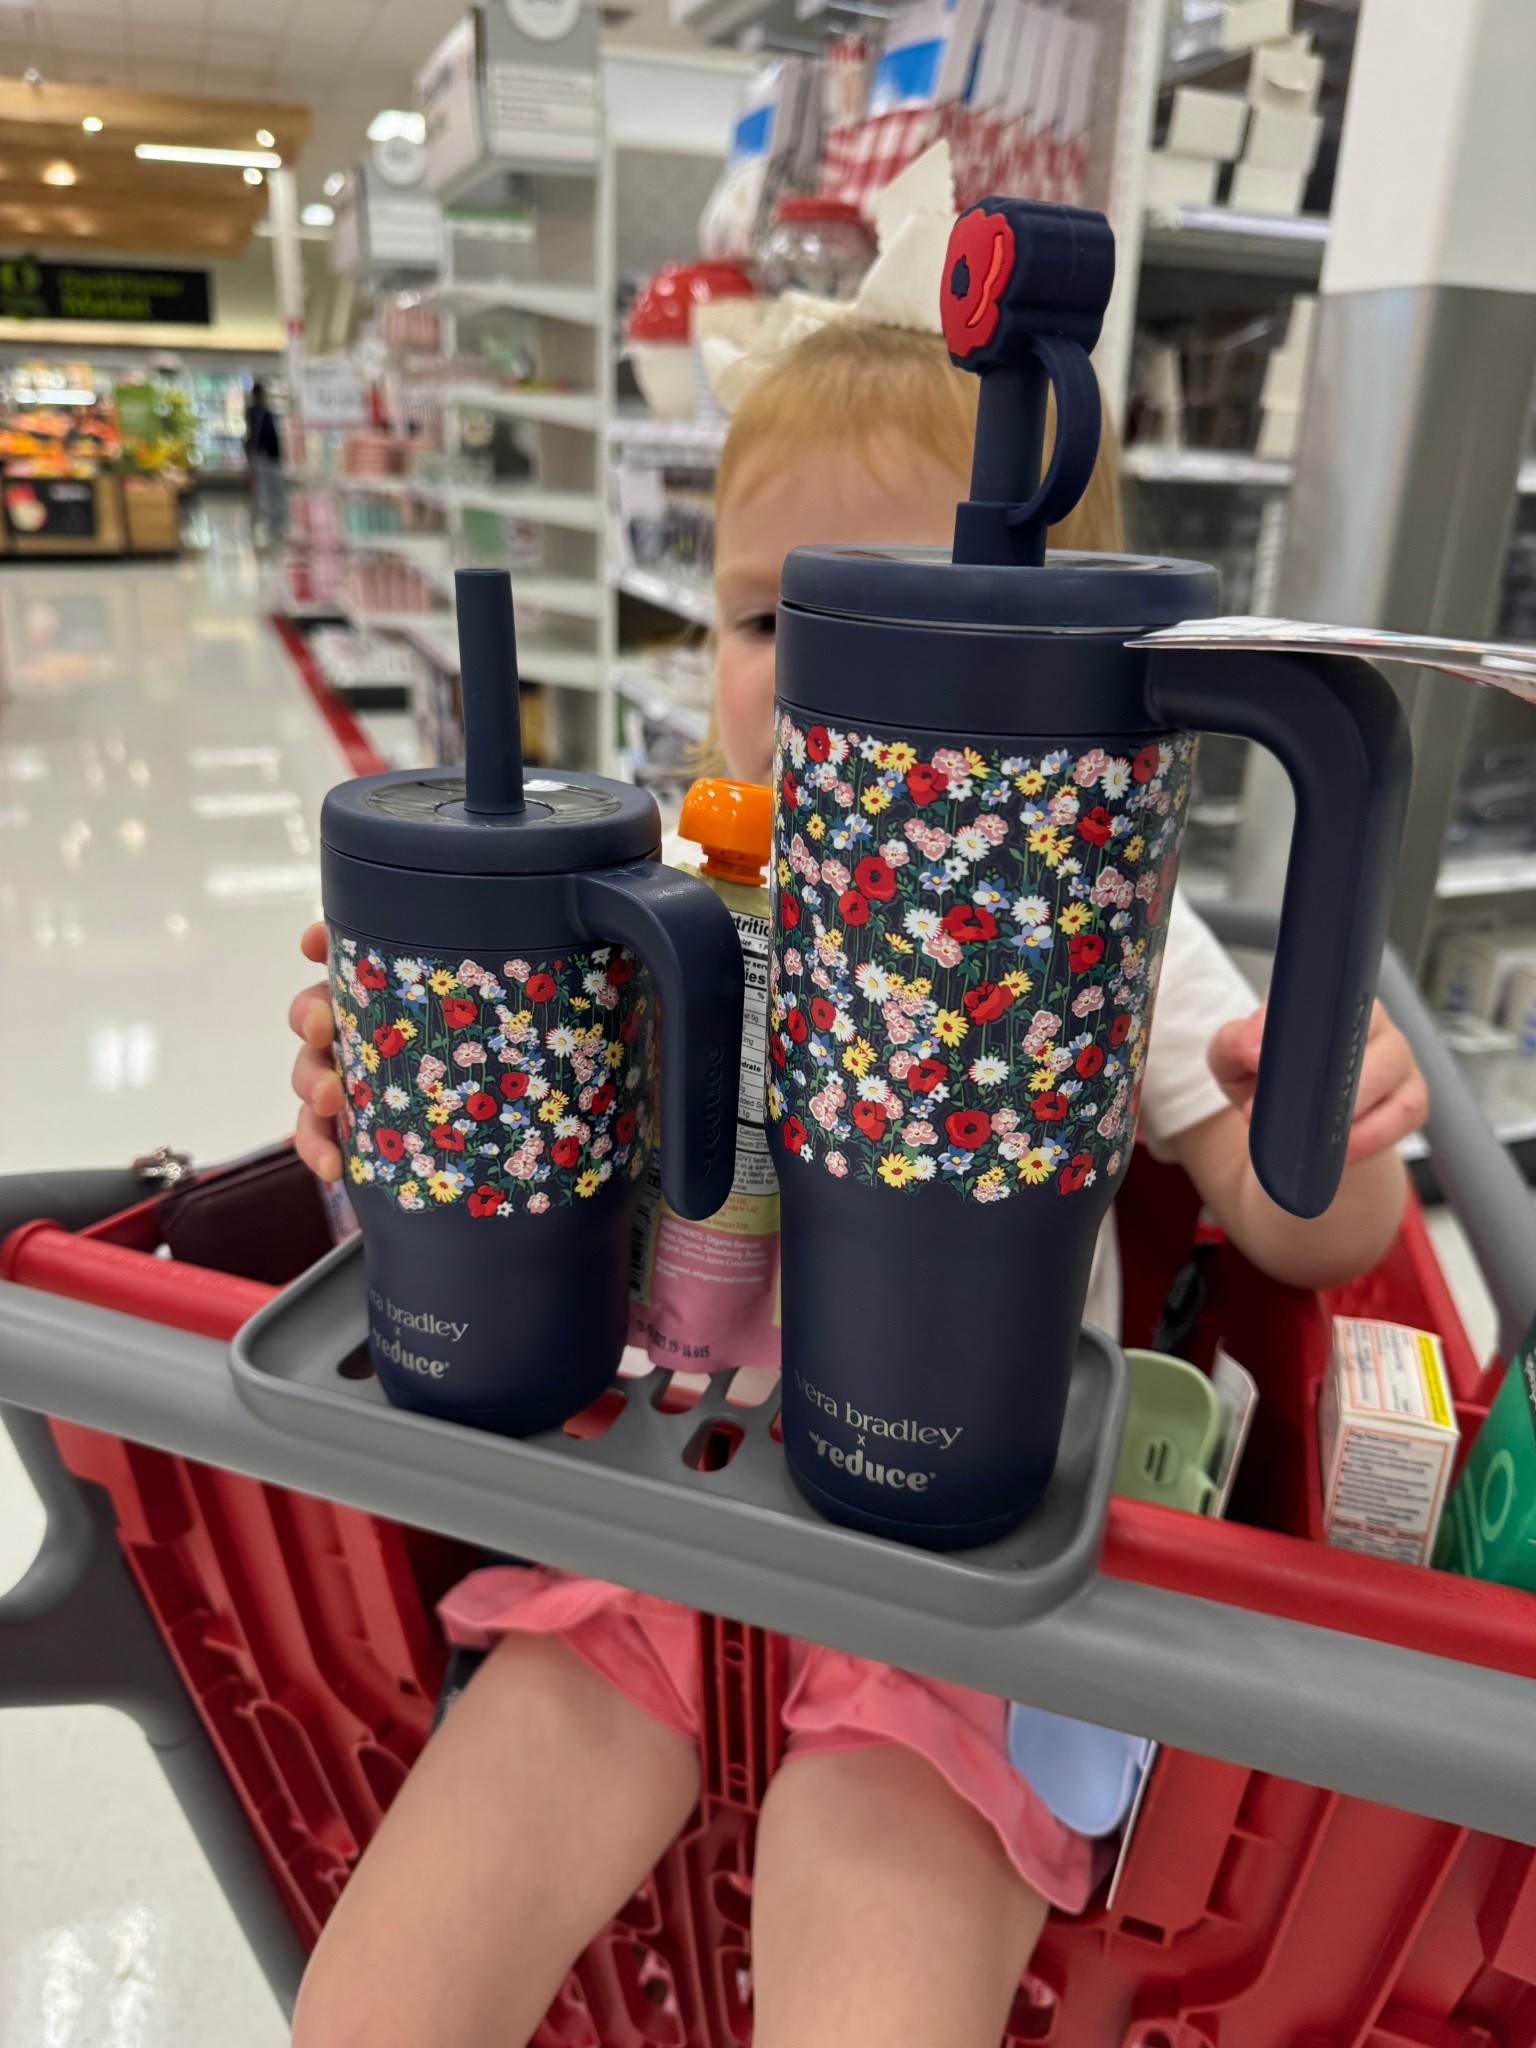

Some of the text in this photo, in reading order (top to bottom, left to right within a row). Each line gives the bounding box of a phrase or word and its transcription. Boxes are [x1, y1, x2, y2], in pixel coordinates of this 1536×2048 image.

[752, 961, 768, 971] serv
[745, 968, 766, 985] ies
[742, 1061, 762, 1073] drate
[739, 1097, 755, 1107] dded
[386, 1297, 469, 1342] bradley
[394, 1326, 402, 1337] x
[794, 1369, 964, 1450] vera bradley
[857, 1433, 866, 1447] x
[814, 1436, 929, 1492] reduce
